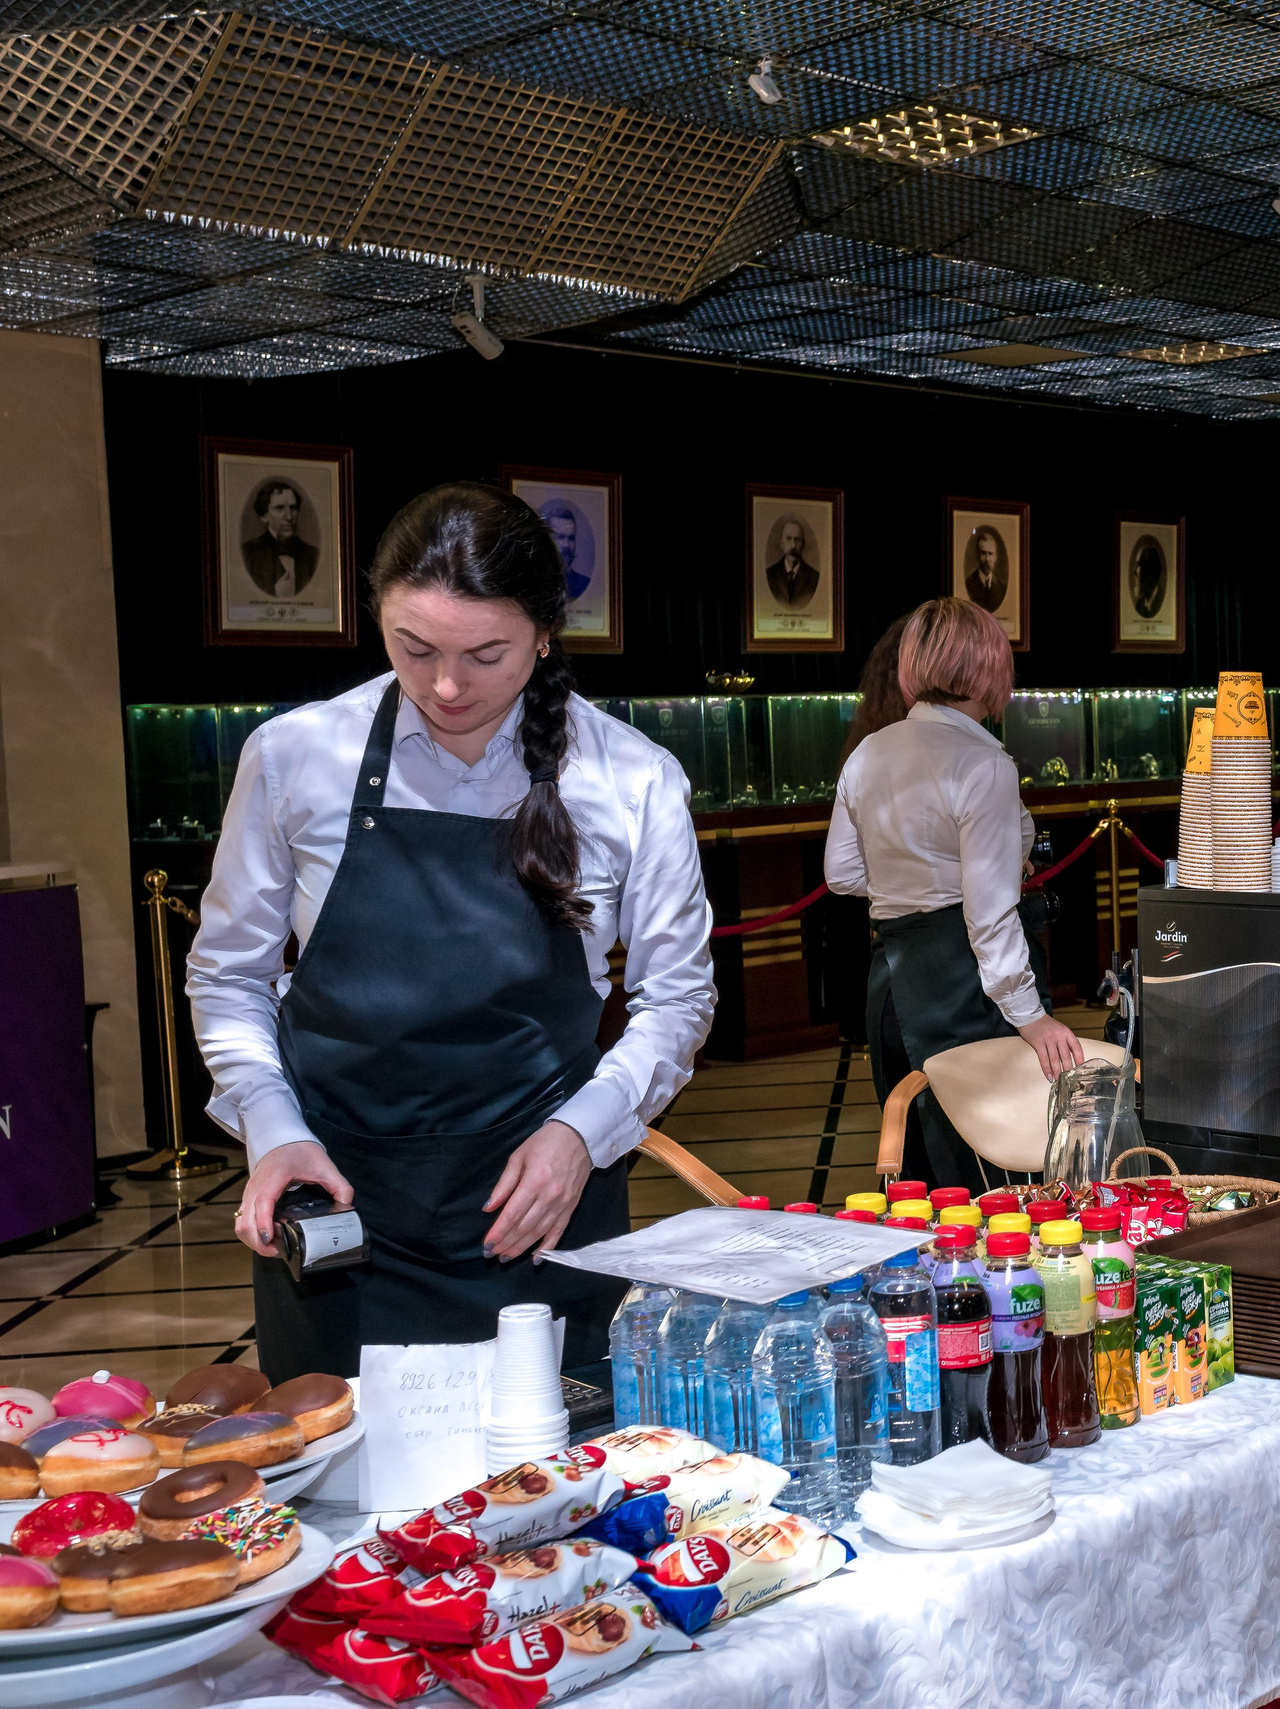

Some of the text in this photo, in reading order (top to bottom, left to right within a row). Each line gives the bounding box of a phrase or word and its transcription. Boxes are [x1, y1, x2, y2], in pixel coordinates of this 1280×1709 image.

[1155, 930, 1188, 943] Jardin
[1095, 1268, 1135, 1285] uzetea
[400, 1372, 436, 1391] 8926
[691, 1488, 732, 1522] Croissant
[507, 1595, 548, 1623] Hazel
